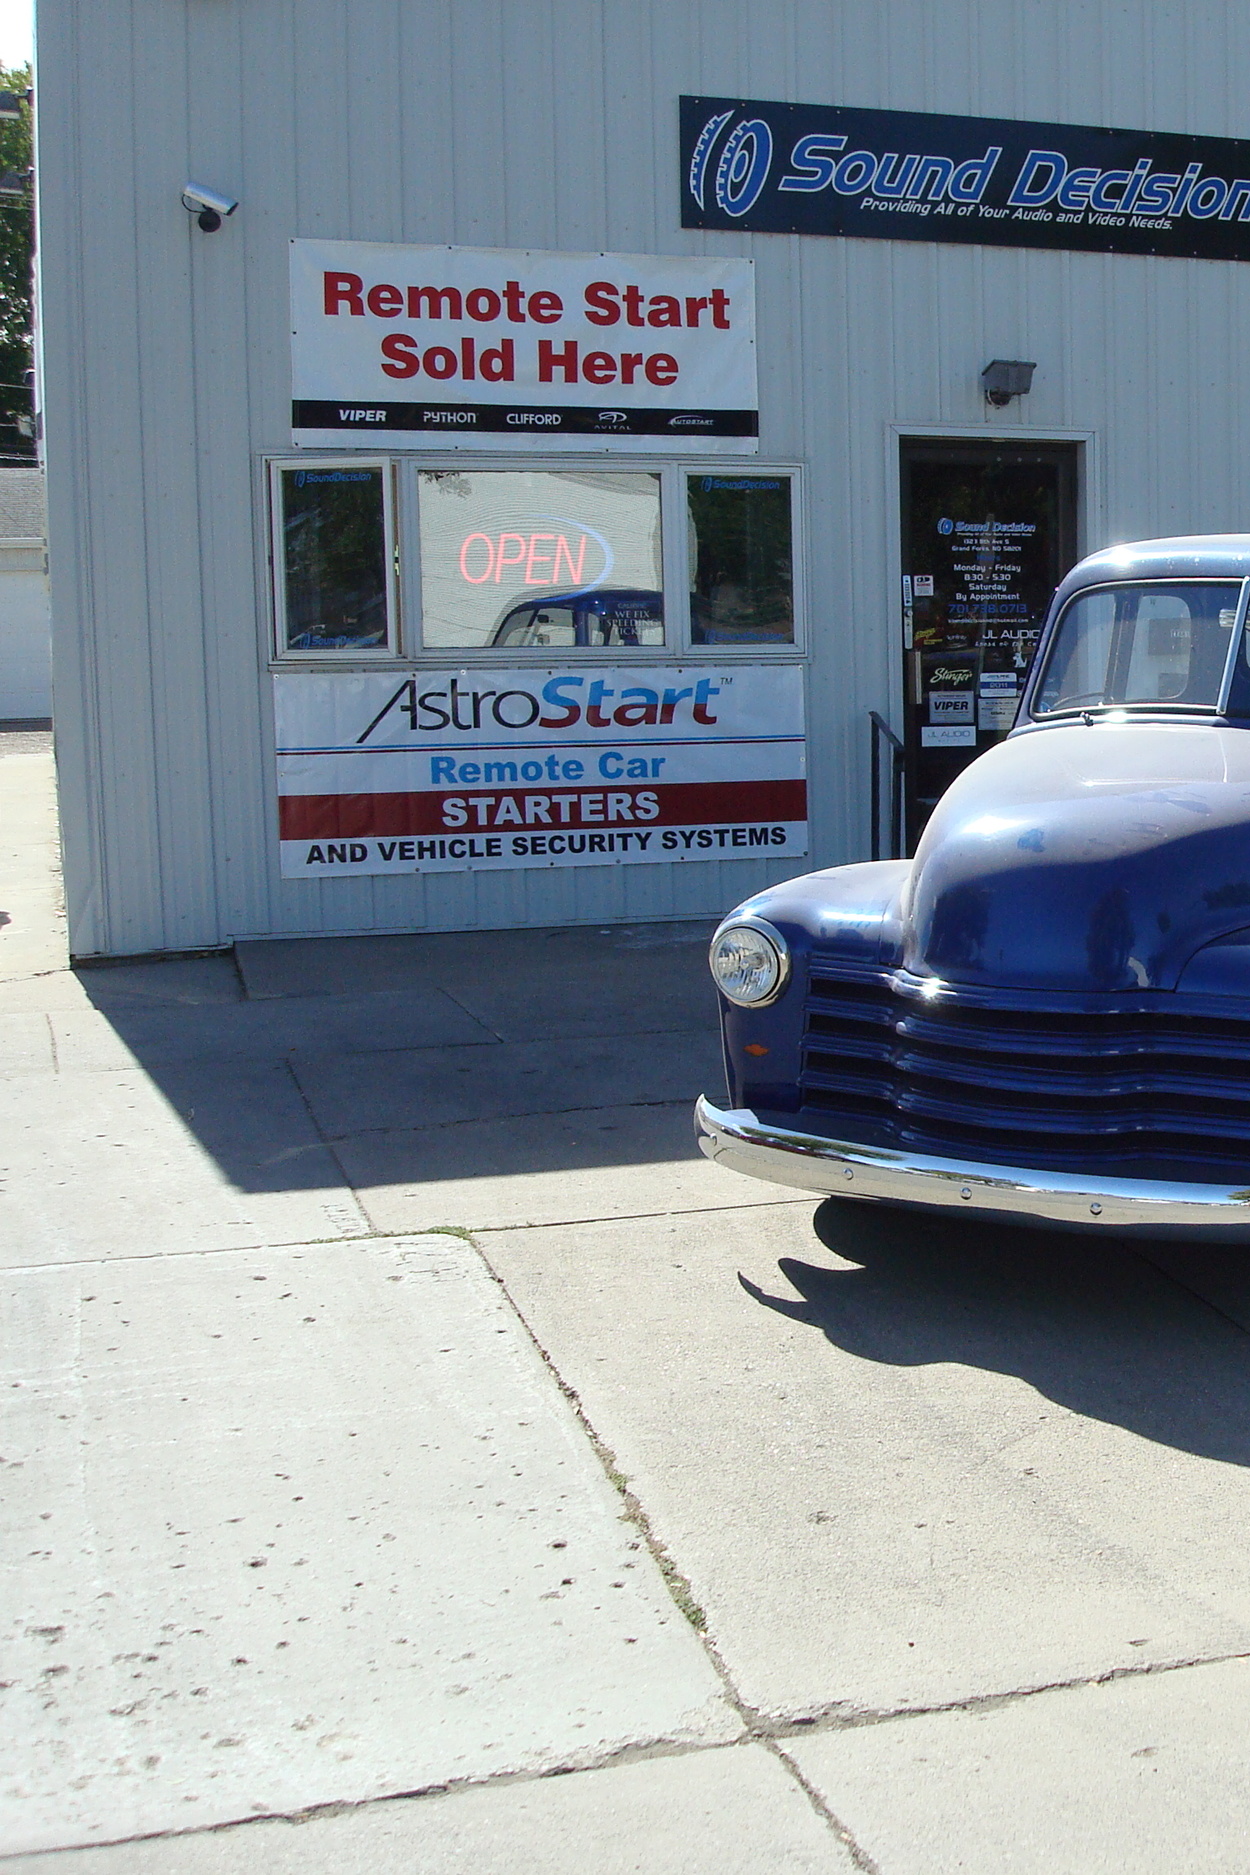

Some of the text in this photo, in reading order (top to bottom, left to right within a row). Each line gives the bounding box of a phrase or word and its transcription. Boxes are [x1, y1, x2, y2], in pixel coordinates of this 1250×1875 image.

[778, 134, 1002, 203] Sound
[860, 197, 1174, 230] Providing All of Your Audio and Video Needs.
[322, 271, 731, 330] Remote Start
[380, 333, 680, 386] Sold Here
[339, 409, 387, 422] VIPER
[423, 411, 477, 424] PYTHON
[506, 413, 562, 425] CLIFFORD
[955, 521, 1037, 532] Sound Decision
[459, 533, 588, 586] OPEN
[953, 564, 986, 572] Monday
[994, 564, 1021, 572] Friday
[968, 583, 1007, 592] Saturday
[955, 593, 1021, 602] By Appointment
[615, 610, 651, 619] WE FIX
[982, 630, 997, 639] JL
[930, 667, 972, 686] Stinger
[934, 701, 969, 710] VIPER
[430, 751, 667, 784] Remote Car
[441, 792, 660, 827] STARTERS
[306, 827, 787, 865] AND VEHICLE SECURITY SYSTEMS
